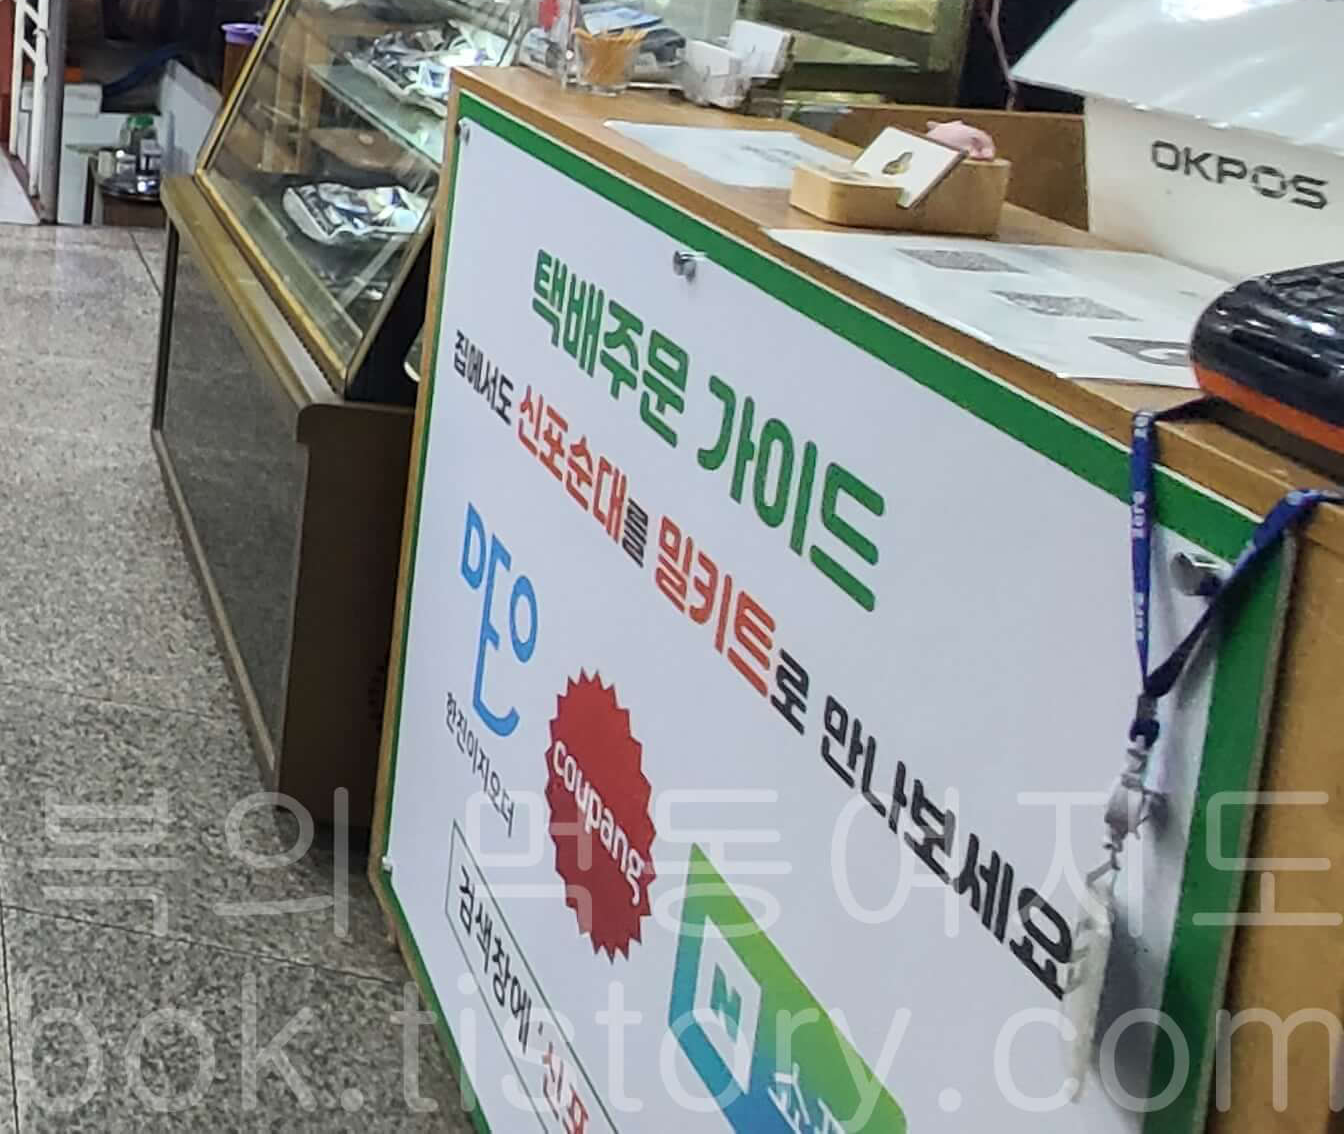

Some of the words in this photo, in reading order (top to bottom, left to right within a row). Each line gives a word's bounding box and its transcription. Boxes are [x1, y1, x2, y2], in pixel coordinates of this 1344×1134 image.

[1151, 139, 1330, 211] OKPOS
[532, 247, 690, 449] 택배주문
[696, 373, 886, 613] 가이드
[453, 329, 514, 427] 집에서도
[518, 384, 649, 569] 신포순대를
[655, 514, 810, 736] 밀키트로
[820, 695, 1074, 1001] 만나보세요
[446, 691, 515, 838] 한진이지오더
[459, 865, 532, 1054] 검색창에
